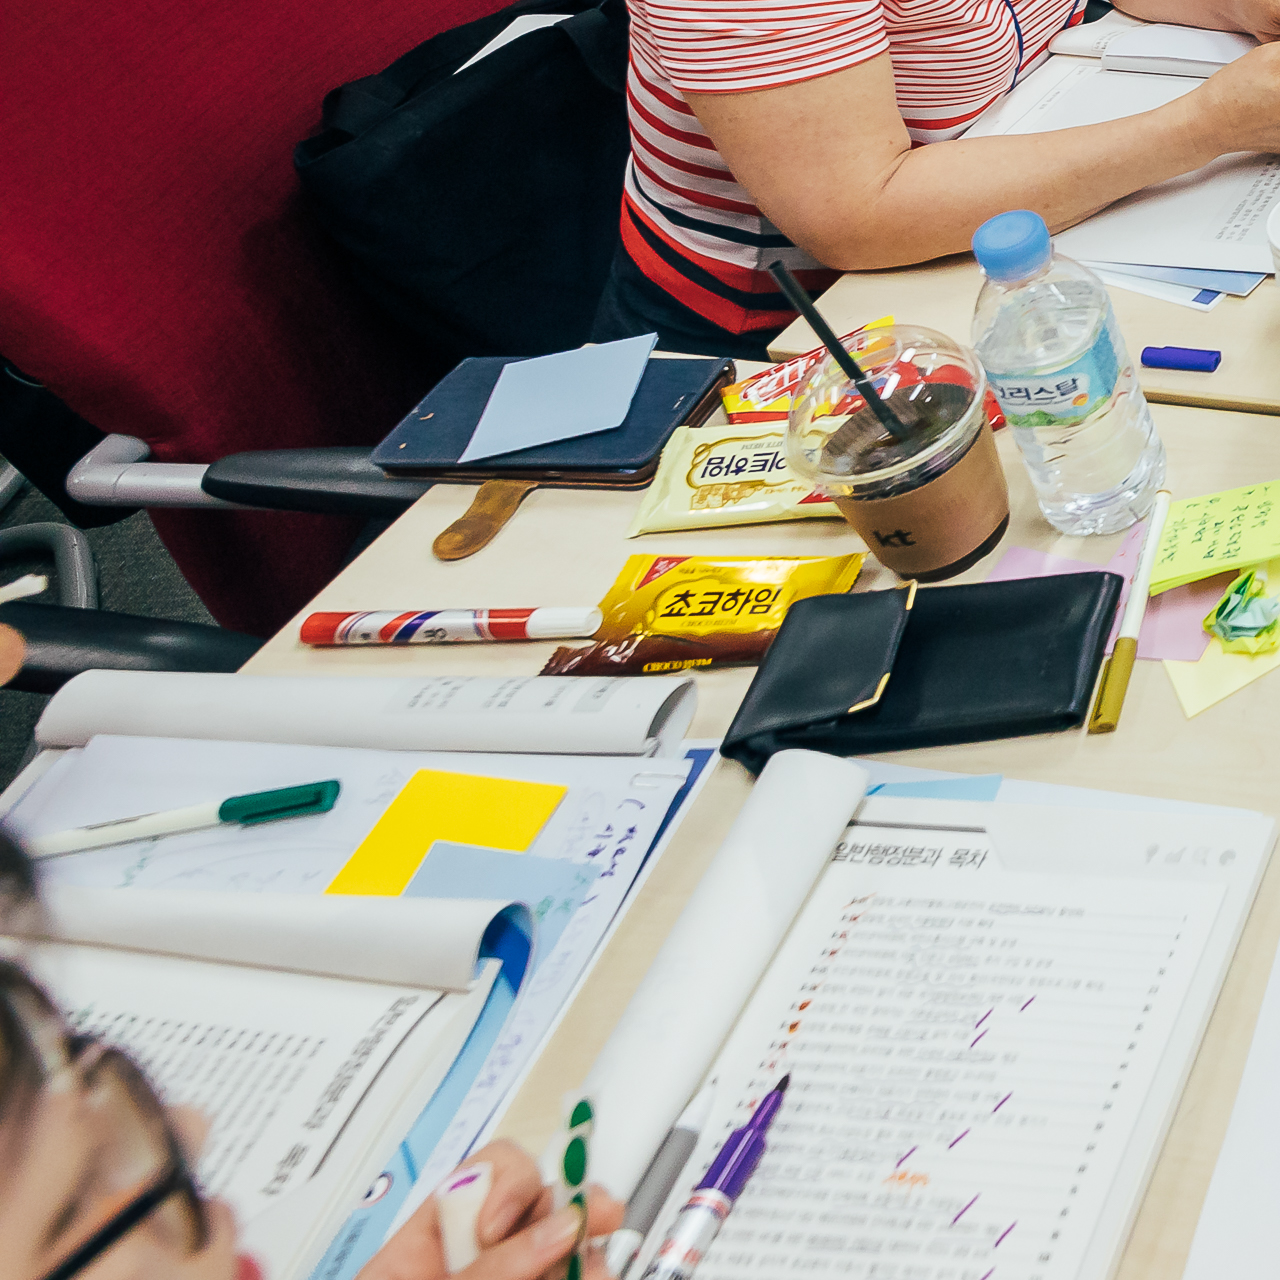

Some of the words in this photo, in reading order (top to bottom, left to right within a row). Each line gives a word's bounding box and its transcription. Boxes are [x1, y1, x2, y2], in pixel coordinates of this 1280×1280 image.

[872, 528, 917, 548] kt
[660, 588, 783, 618] 초코하임
[948, 847, 990, 870] 목차
